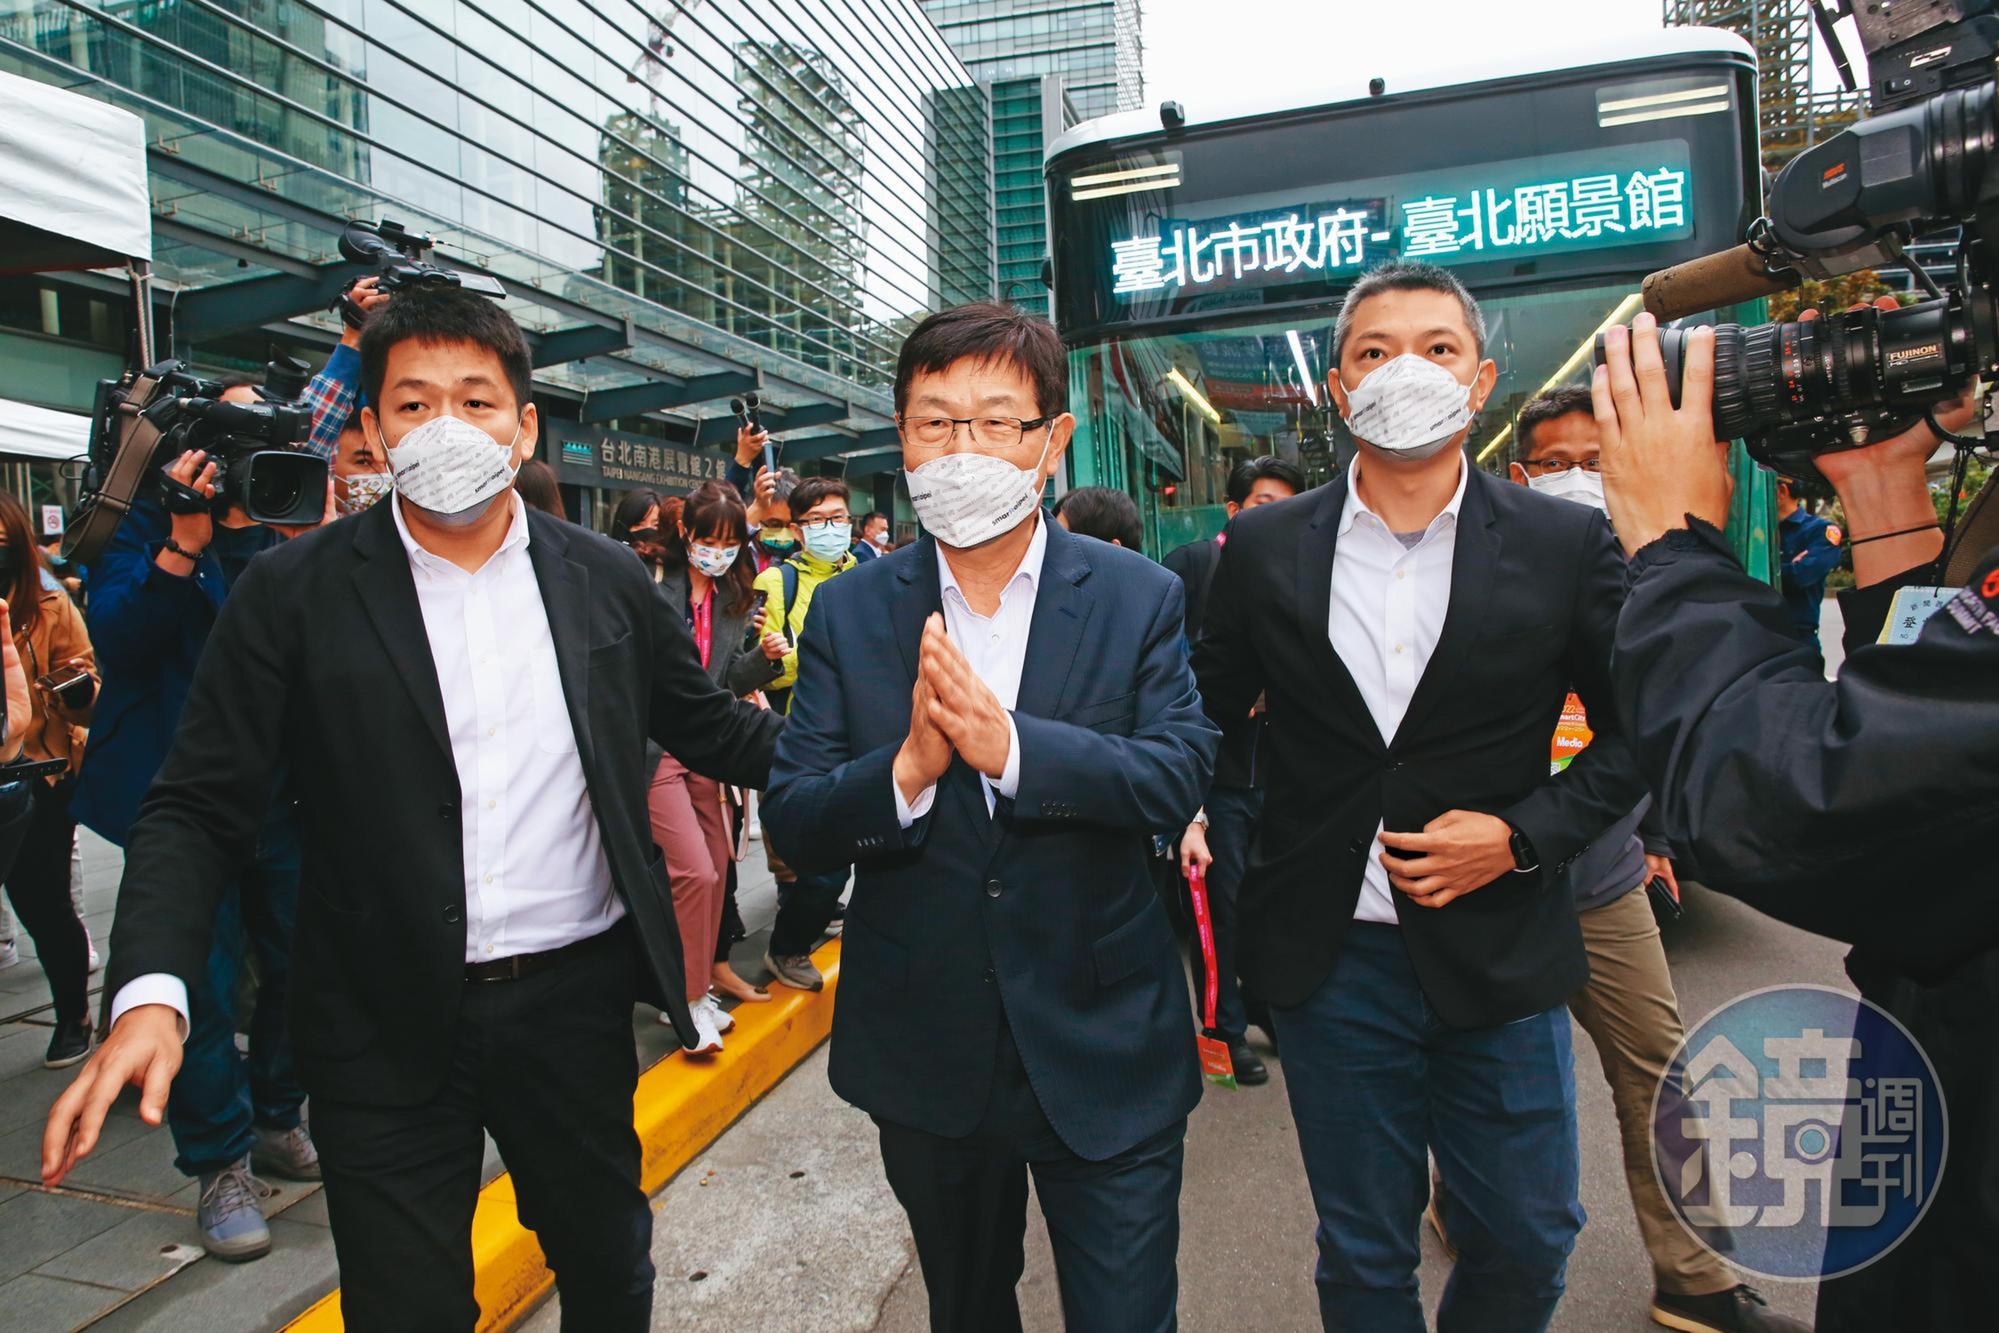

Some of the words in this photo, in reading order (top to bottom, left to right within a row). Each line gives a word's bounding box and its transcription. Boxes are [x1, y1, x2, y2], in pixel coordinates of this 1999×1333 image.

[1401, 166, 1685, 257] 臺北願景館
[1889, 344, 1937, 361] FUJINON
[602, 465, 623, 479] TAIPEI
[623, 469, 656, 484] NANGANG
[1557, 736, 1583, 748] Media
